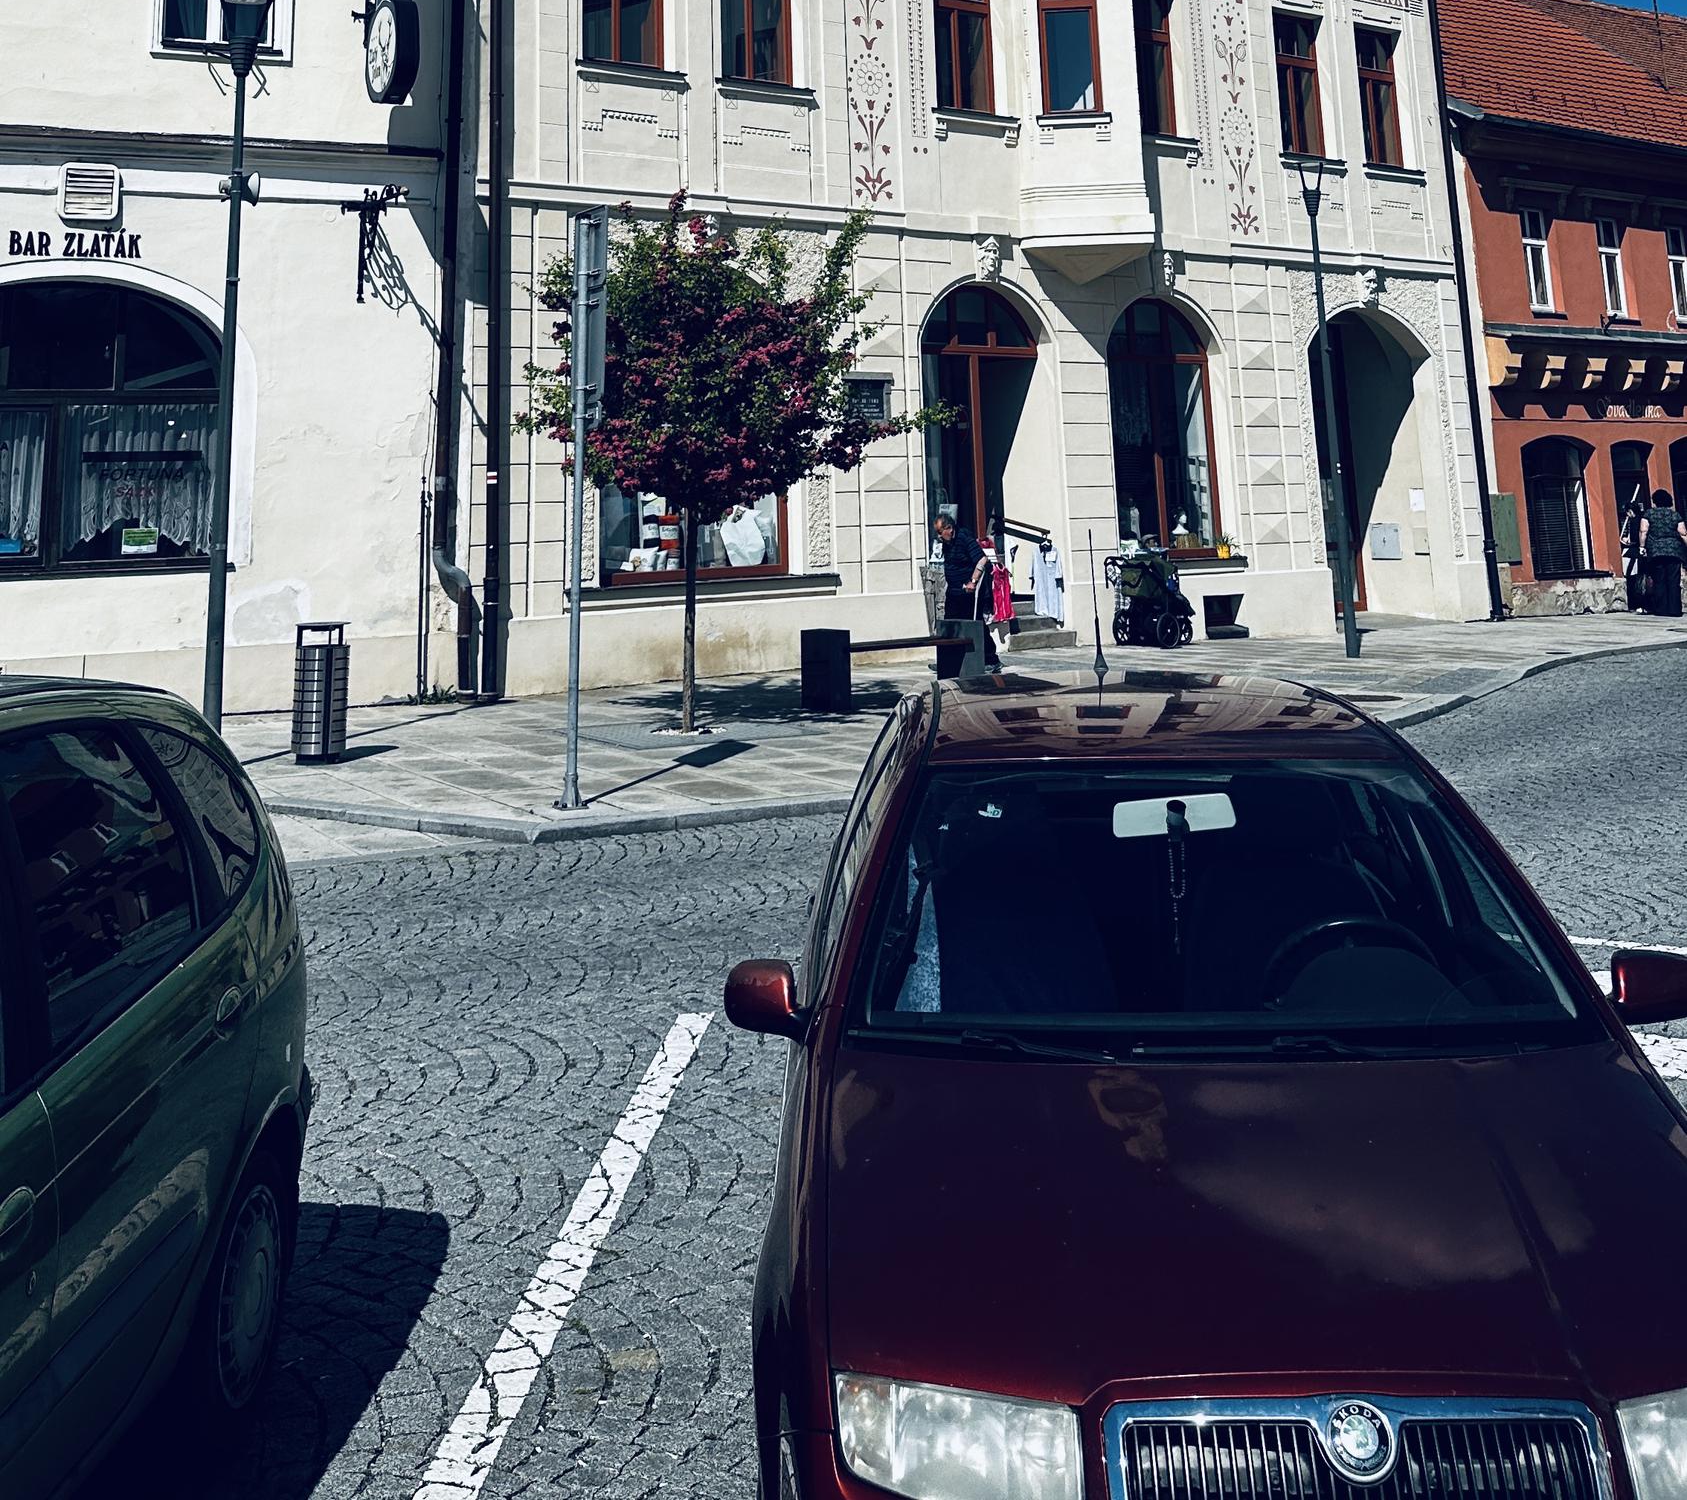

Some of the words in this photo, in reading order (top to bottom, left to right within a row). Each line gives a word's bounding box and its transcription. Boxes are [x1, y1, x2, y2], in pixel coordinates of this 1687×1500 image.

[9, 230, 51, 257] BAR
[62, 227, 142, 259] ZLAŤÁK
[100, 467, 184, 481] FORTUNA
